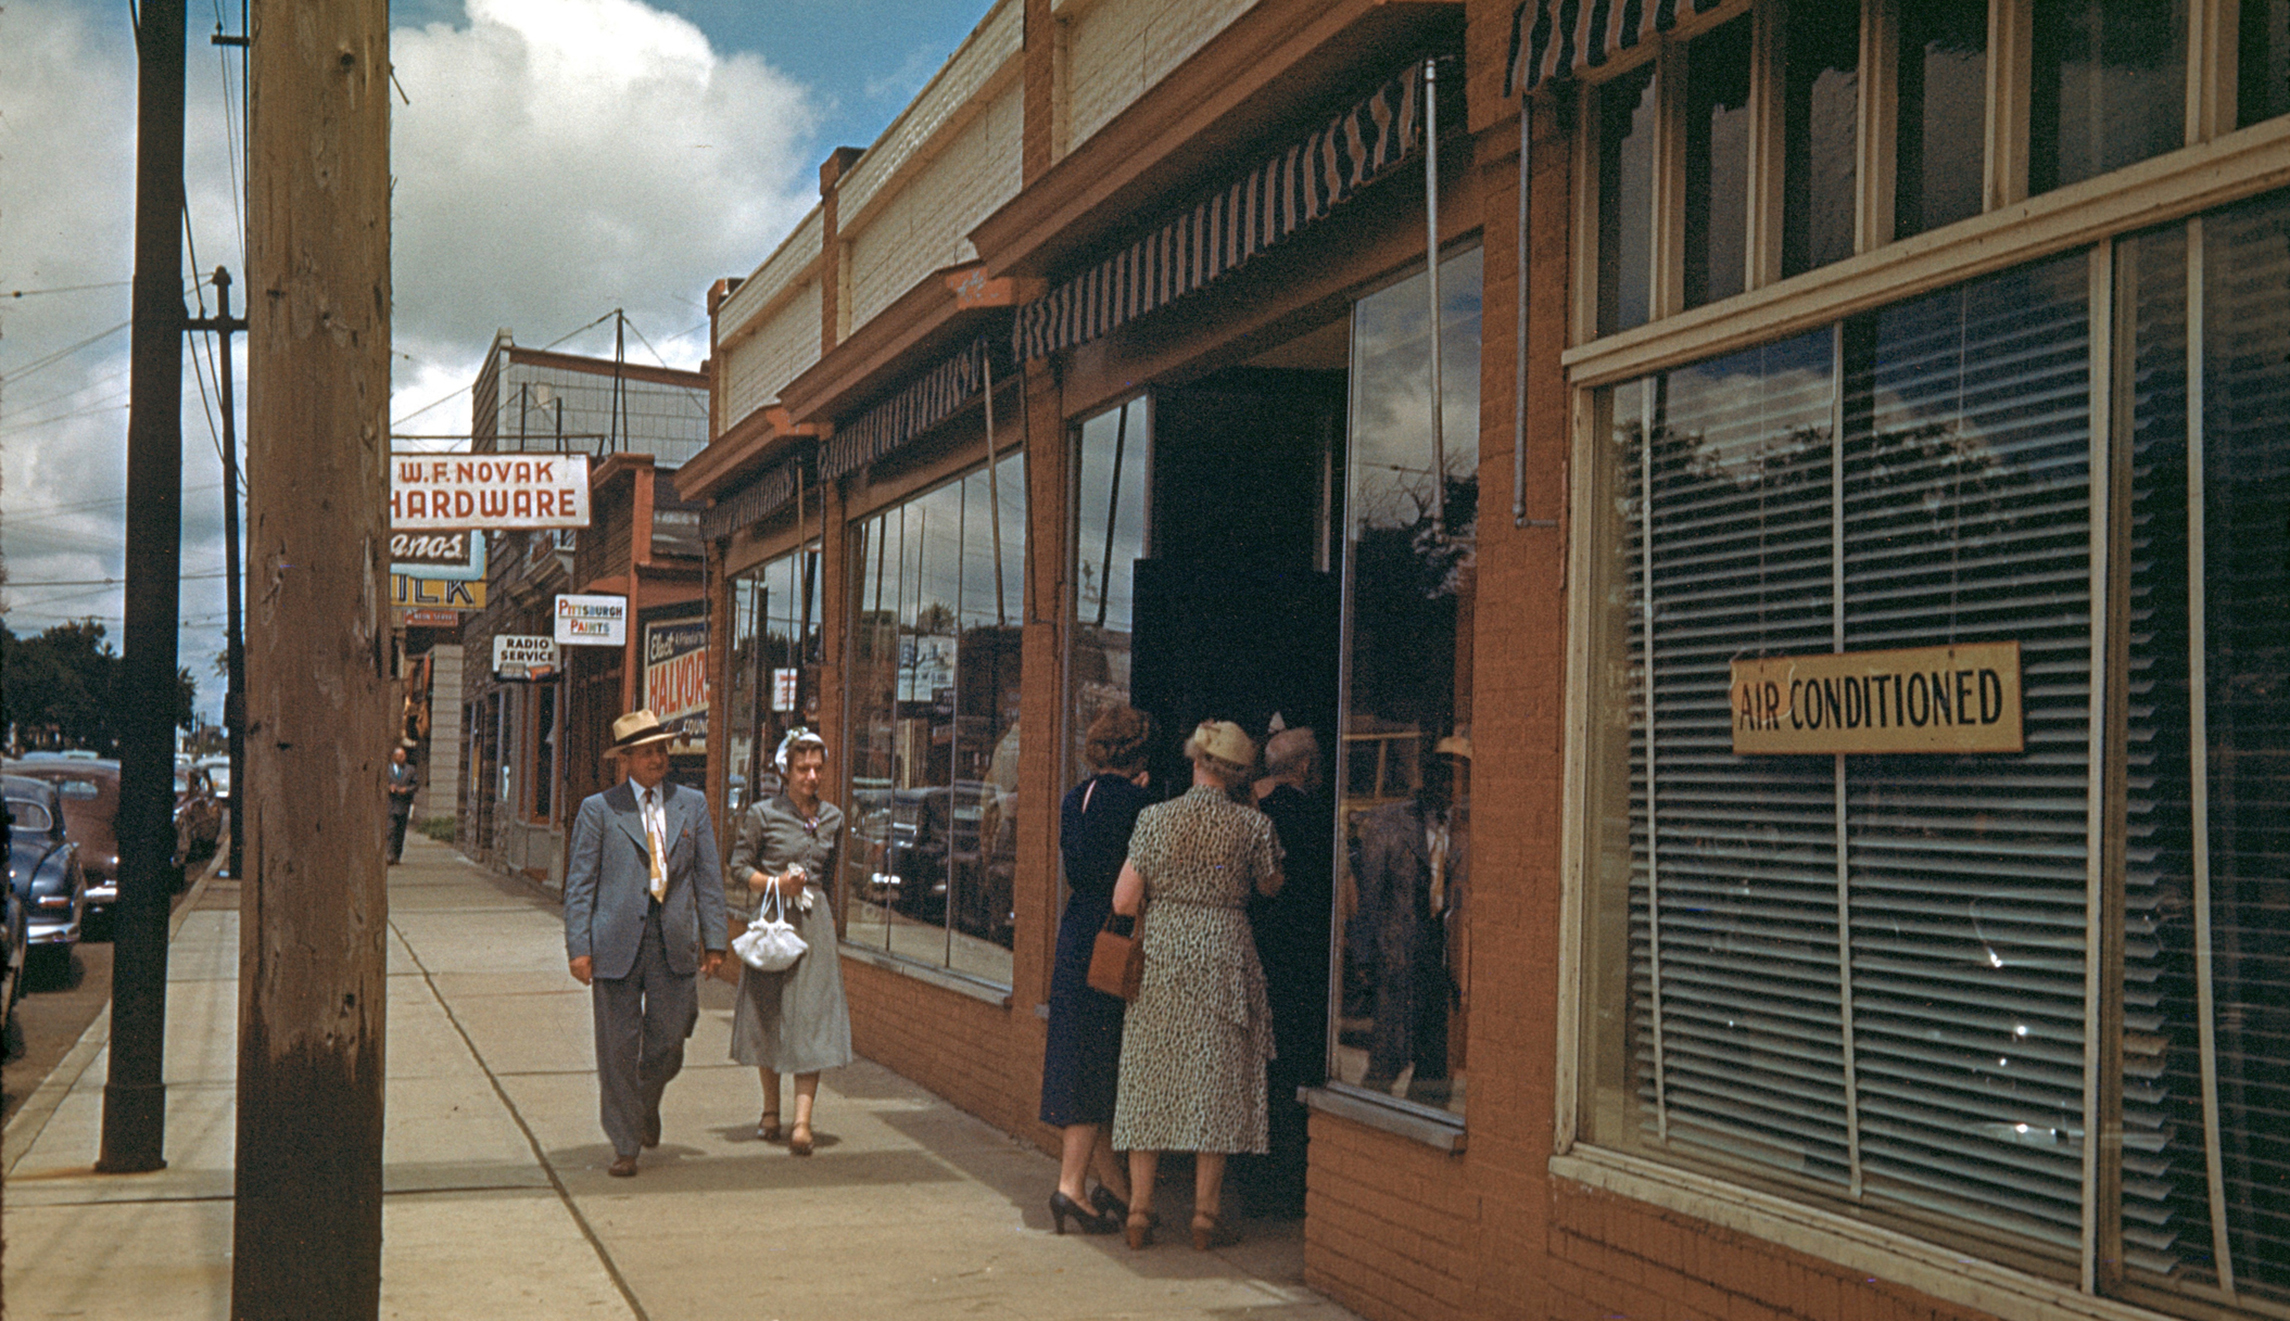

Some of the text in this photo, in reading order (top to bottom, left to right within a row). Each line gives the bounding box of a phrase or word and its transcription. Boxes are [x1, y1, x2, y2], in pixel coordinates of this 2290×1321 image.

[455, 461, 554, 484] NOVAK
[570, 619, 610, 634] PAINTS
[506, 638, 549, 650] RADIO
[500, 650, 555, 662] SERVICE
[649, 649, 711, 718] HALVOR
[1738, 668, 2004, 732] AIR CONDITIONED
